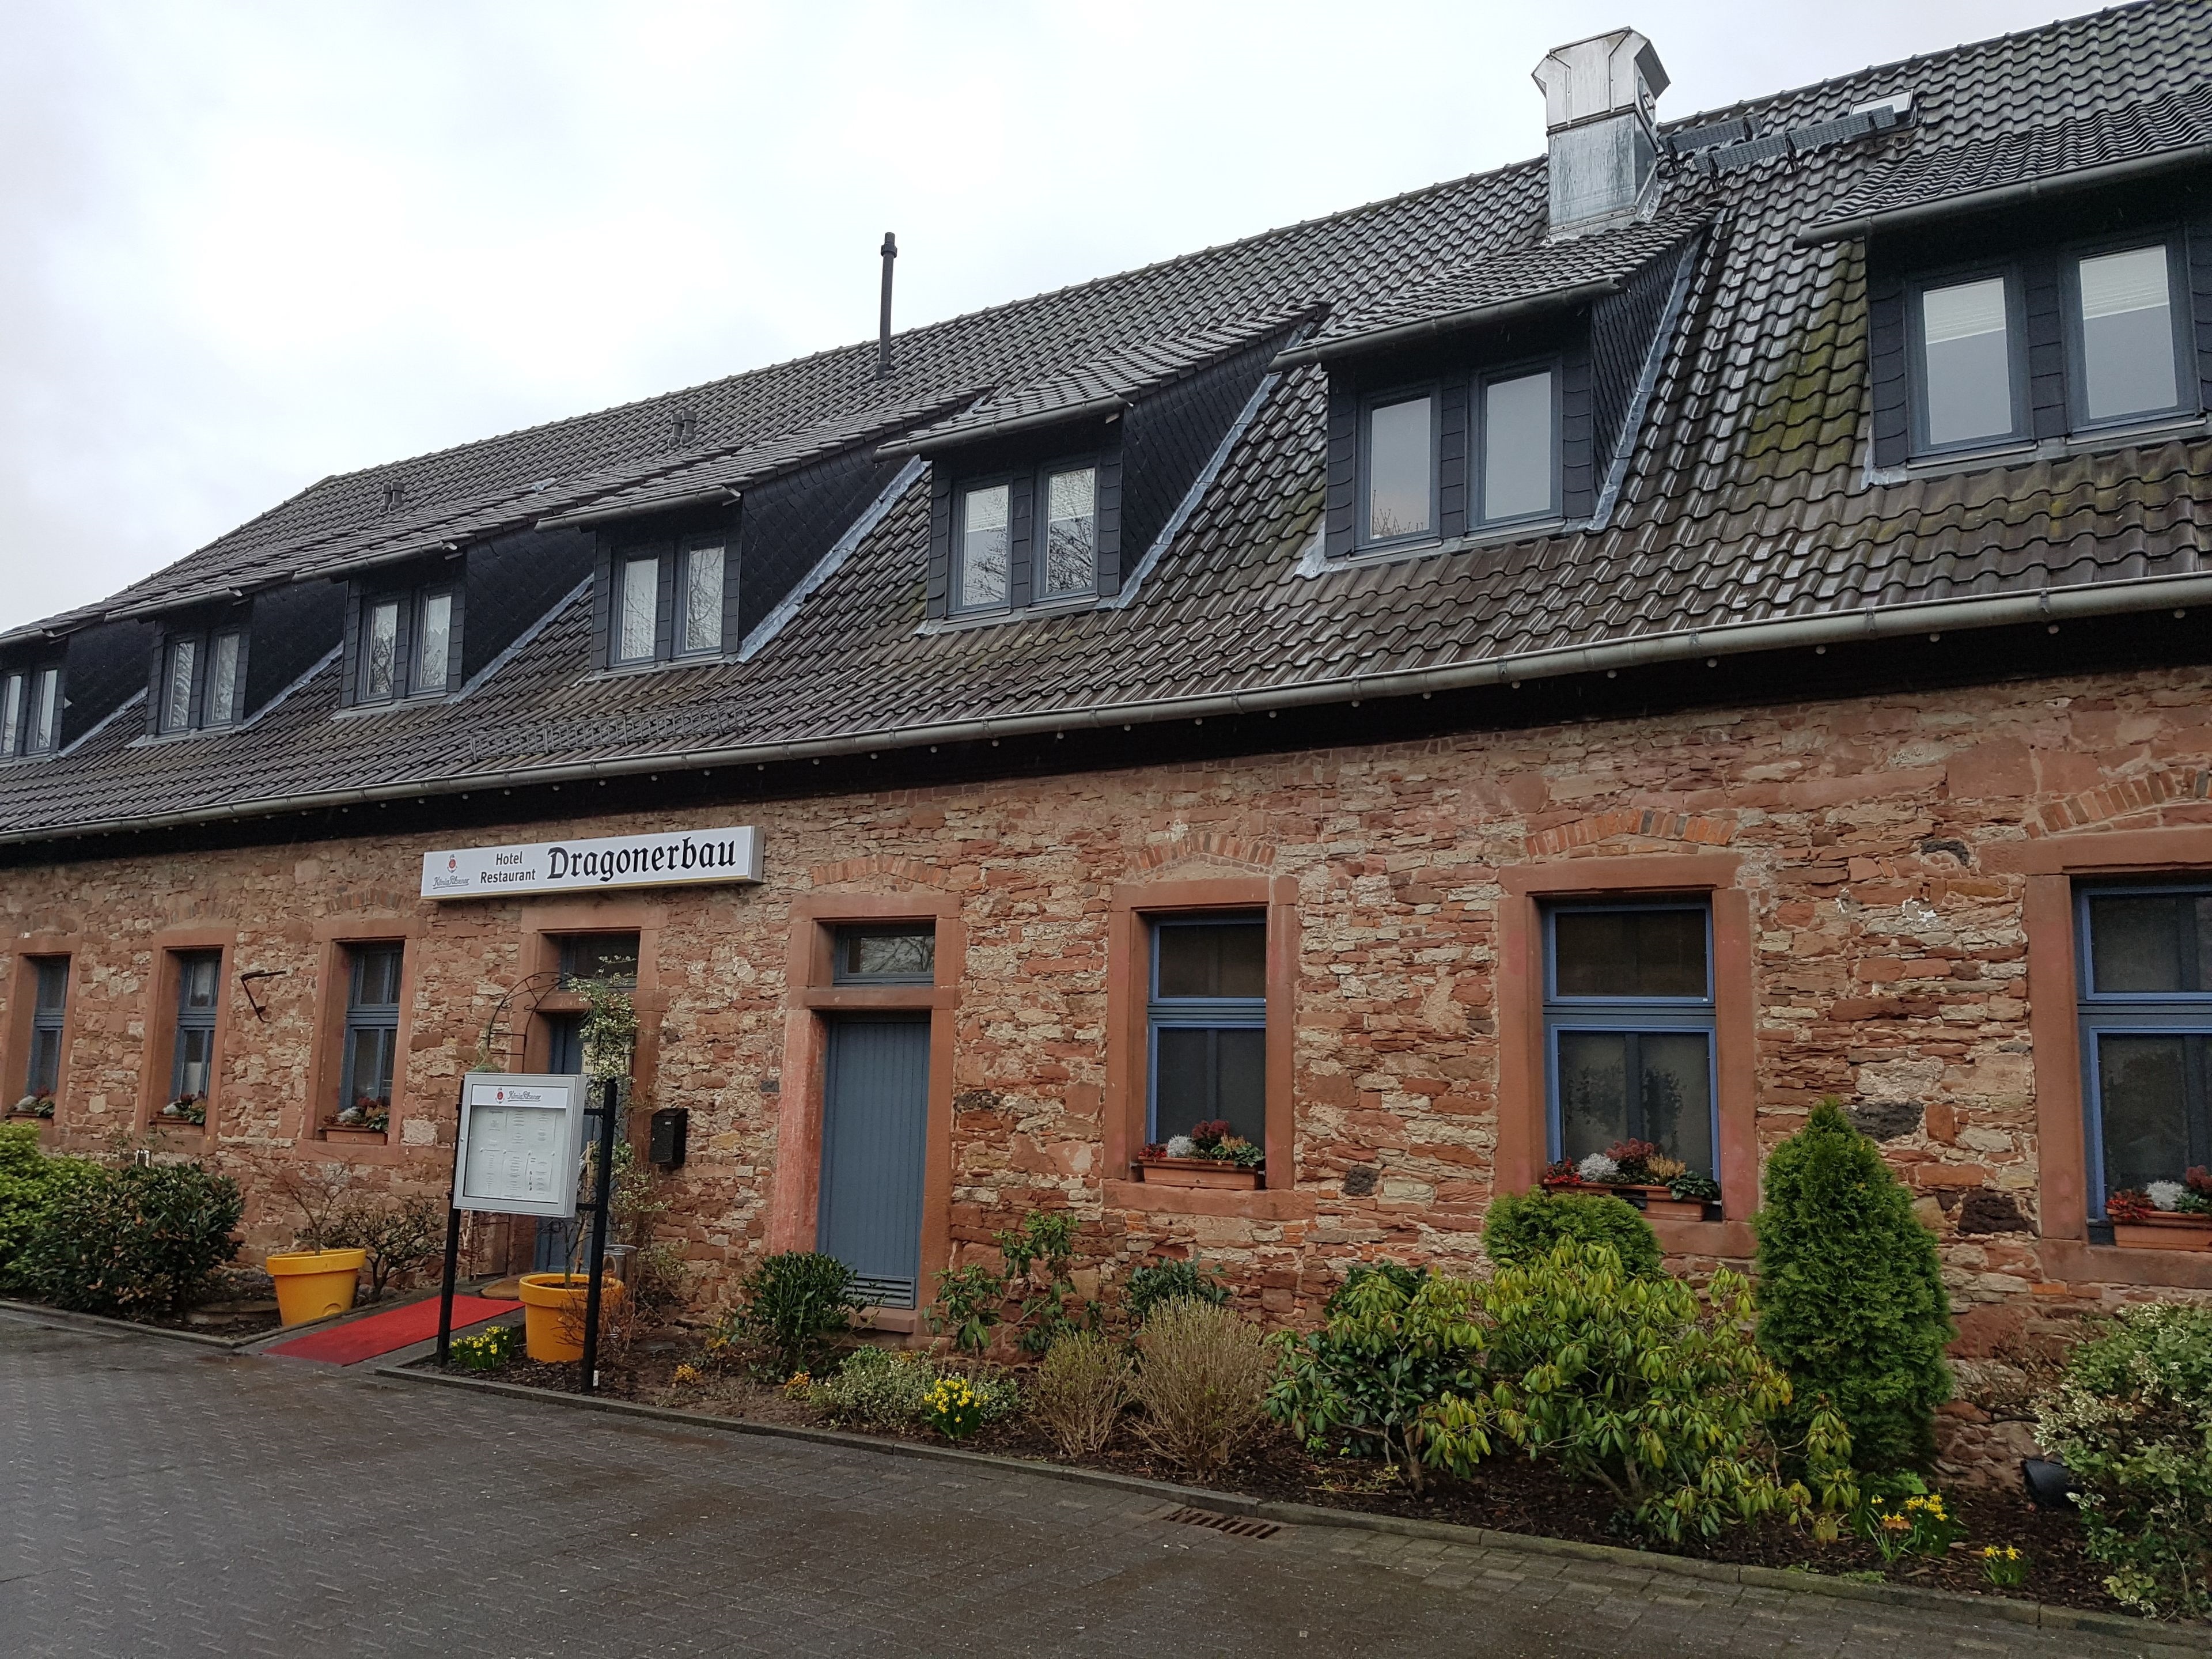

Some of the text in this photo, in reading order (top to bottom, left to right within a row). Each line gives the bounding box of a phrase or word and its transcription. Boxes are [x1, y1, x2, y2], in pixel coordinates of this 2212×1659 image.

[496, 851, 522, 866] Hotel
[547, 836, 736, 882] Dragonerbau
[480, 868, 536, 884] Restaurant
